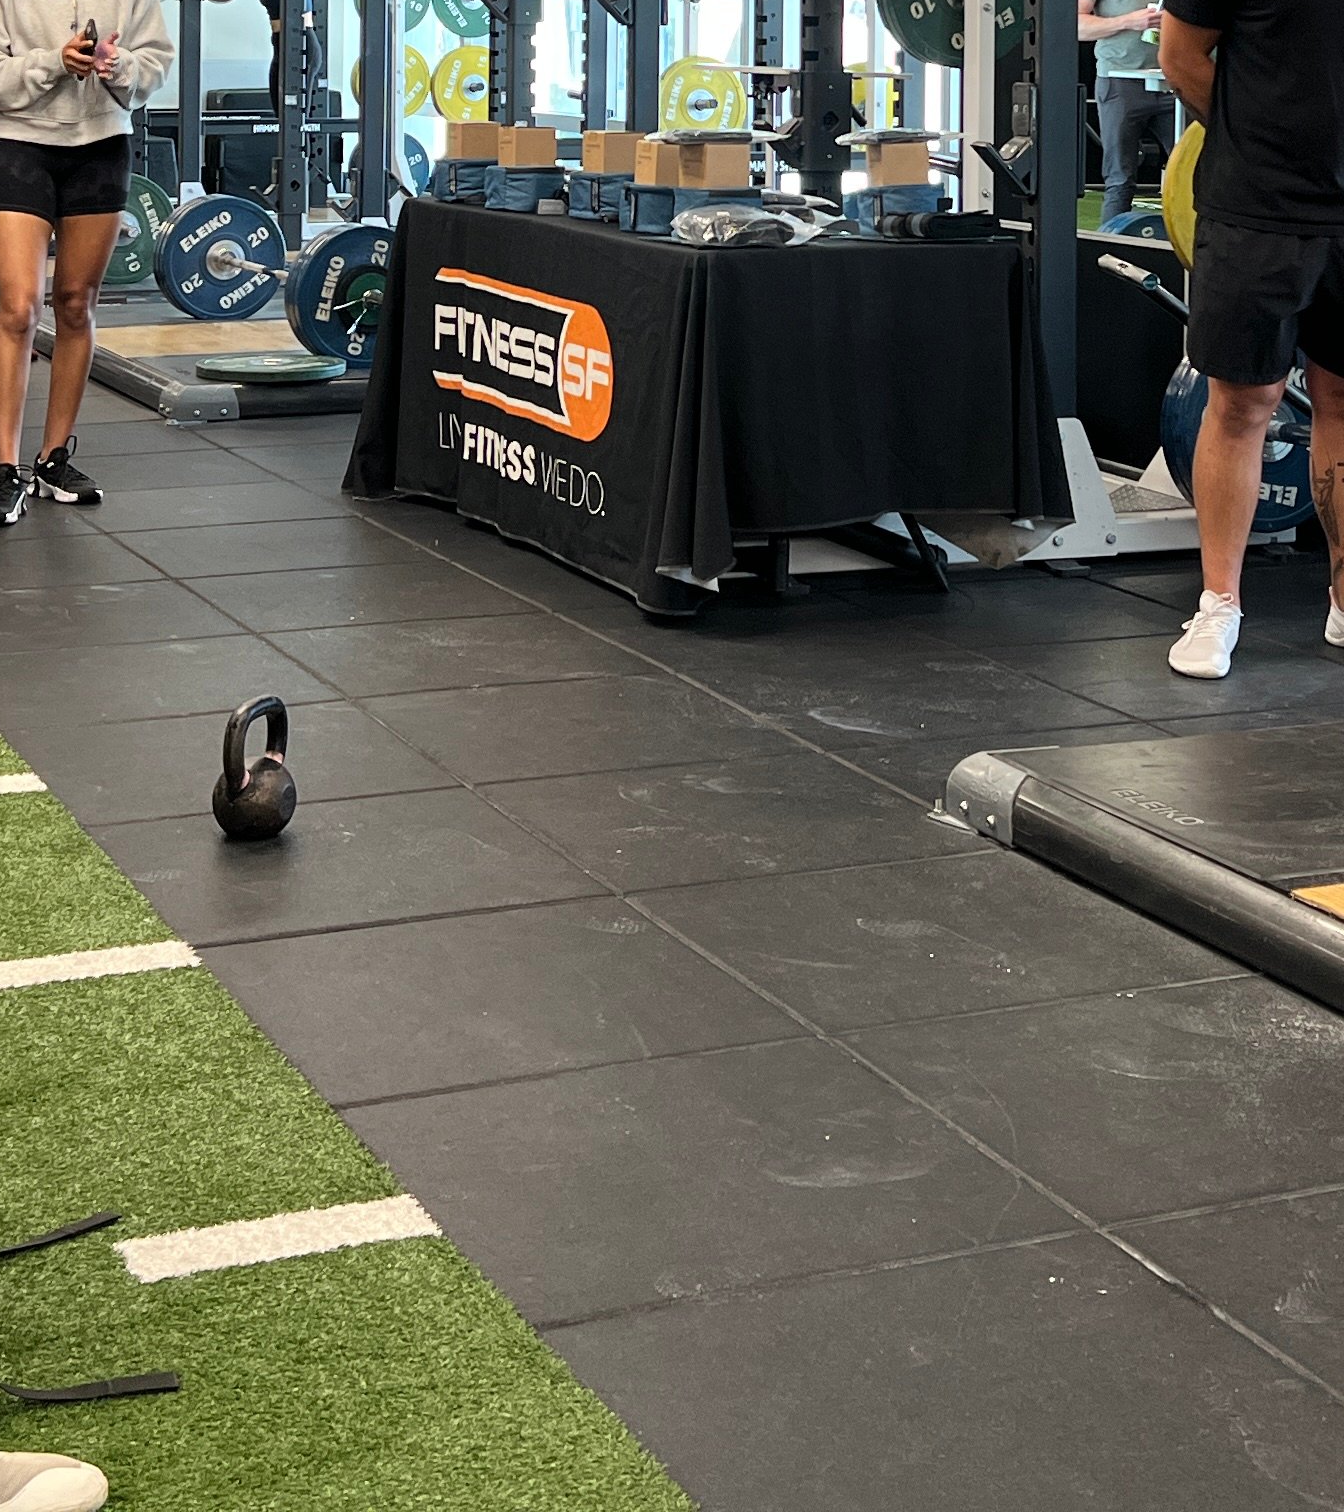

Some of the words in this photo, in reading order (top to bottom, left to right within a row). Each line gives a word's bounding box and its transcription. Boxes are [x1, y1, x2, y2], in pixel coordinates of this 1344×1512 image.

[476, 55, 488, 68] 15
[443, 59, 462, 100] ELEIKO
[665, 76, 684, 121] ELEIKO
[461, 106, 472, 120] 15
[408, 153, 423, 166] 20
[178, 210, 233, 254] ELEIKO
[247, 226, 270, 249] 20
[124, 252, 142, 273] 10
[370, 239, 389, 267] 20
[180, 272, 205, 295] 20
[314, 255, 346, 323] ELEIKO
[346, 332, 366, 356] 20
[434, 302, 555, 388] FITNESS
[562, 342, 610, 401] SF
